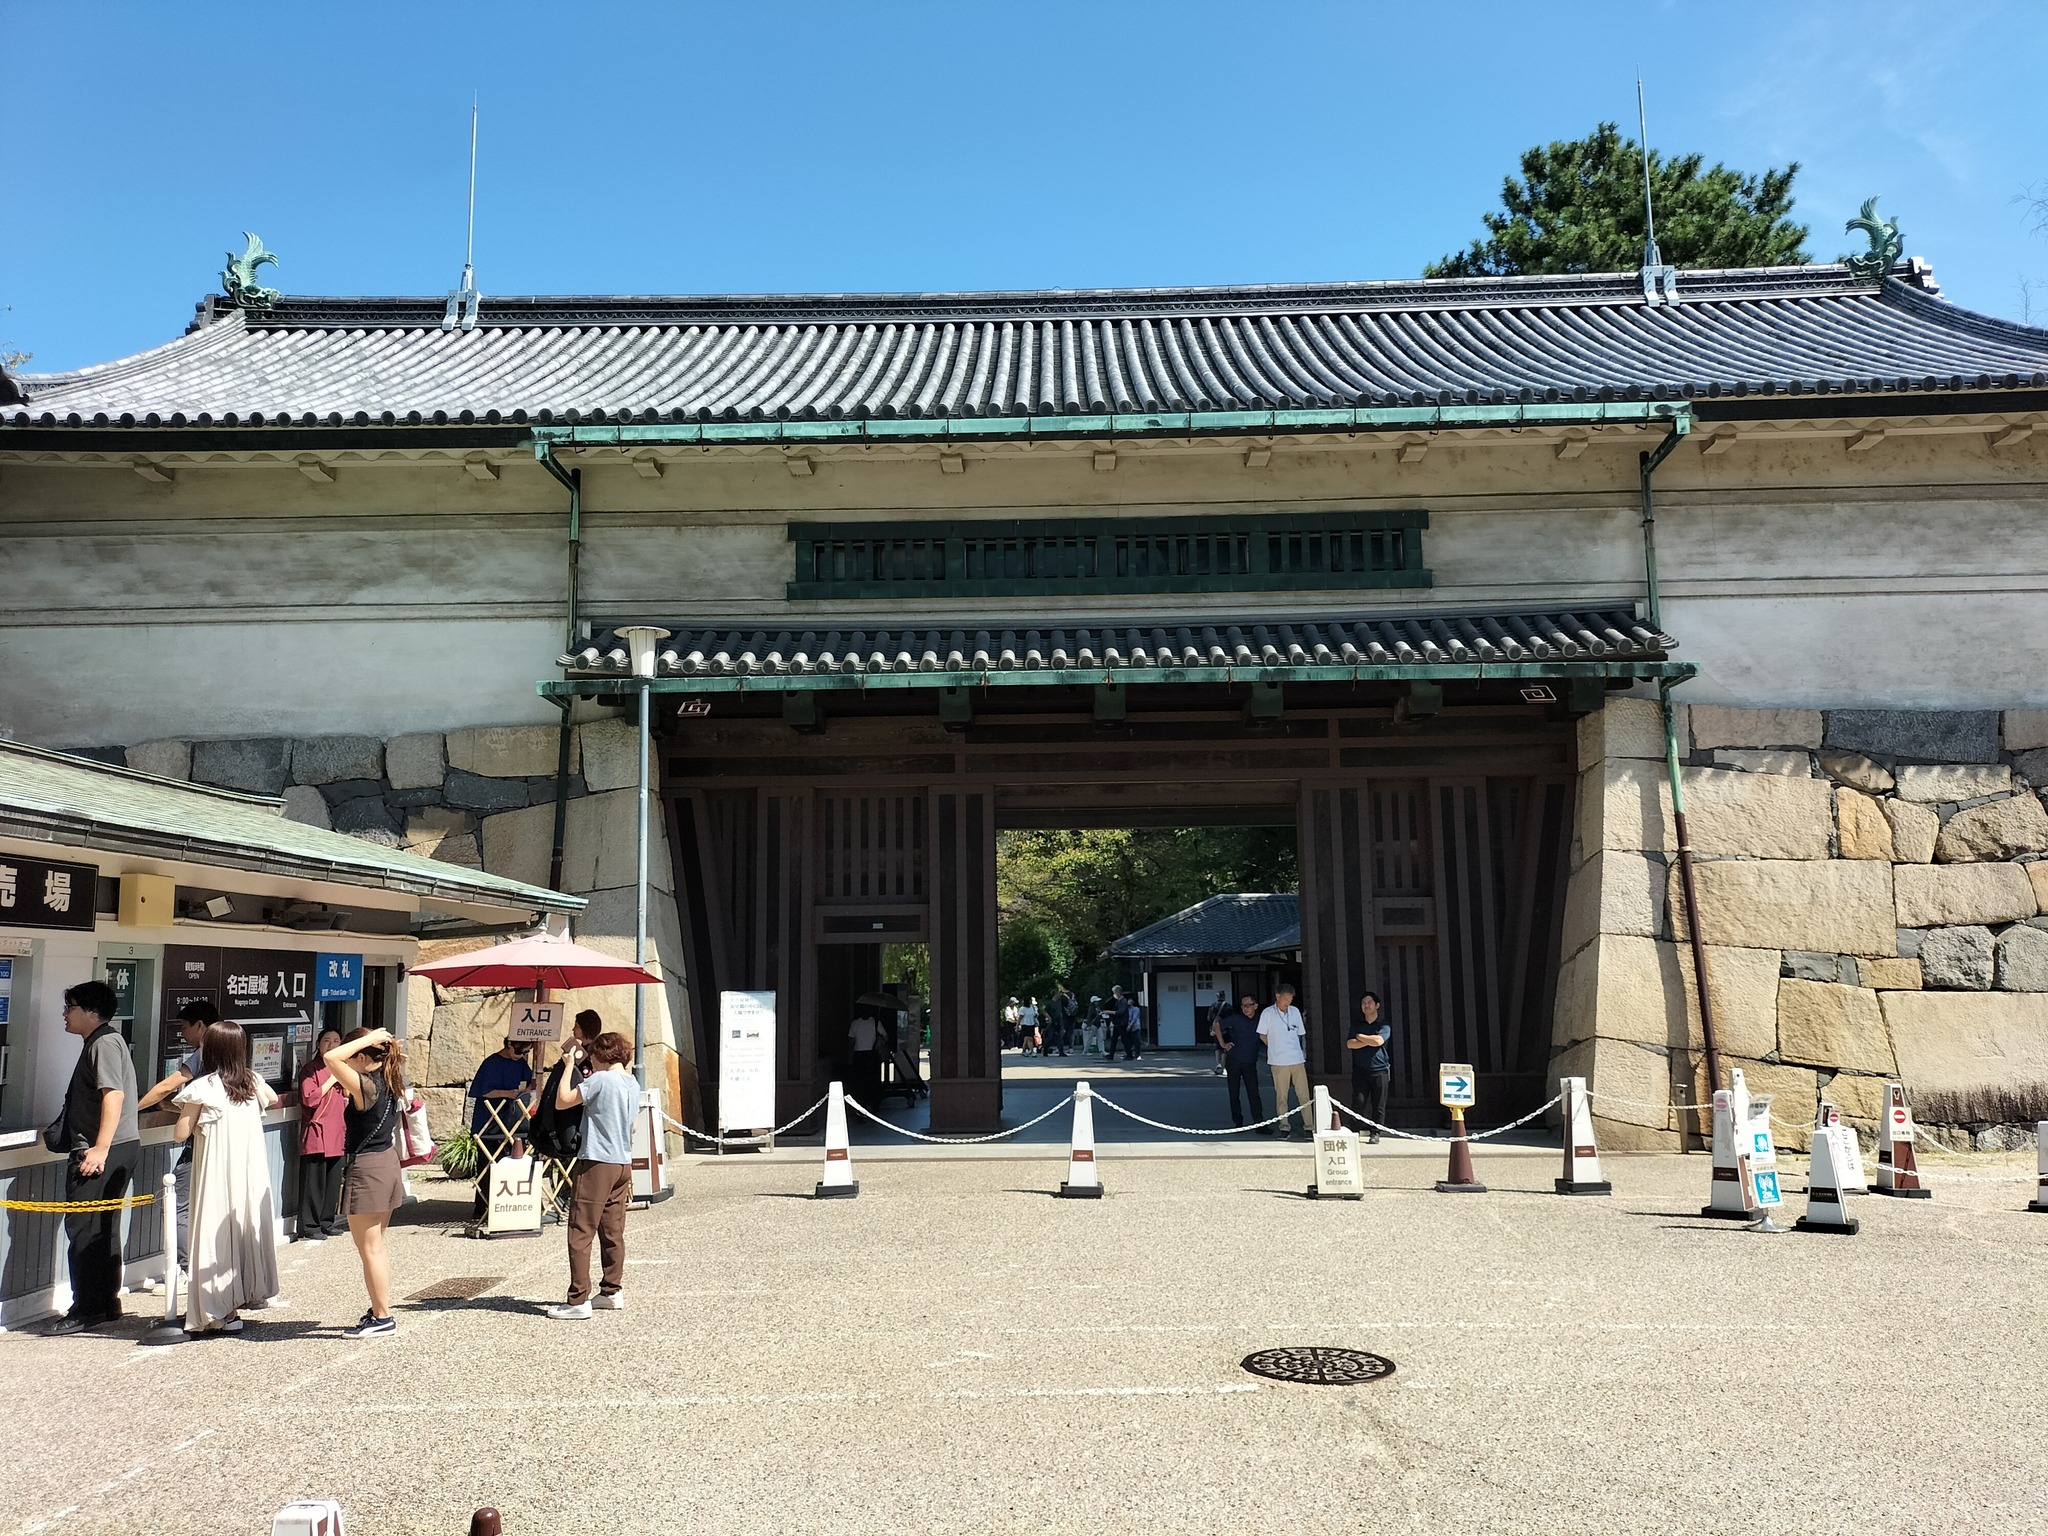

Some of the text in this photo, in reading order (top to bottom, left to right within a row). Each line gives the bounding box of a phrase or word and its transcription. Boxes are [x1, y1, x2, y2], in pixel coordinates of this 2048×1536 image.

[128, 946, 134, 955] 3
[328, 960, 351, 978] 改札
[188, 972, 200, 980] OPEN
[226, 971, 307, 998] 名古屋城 入口
[234, 999, 249, 1007] Nagoya
[521, 1008, 551, 1023] 入口
[516, 1028, 552, 1037] ENTRANCE
[1323, 1140, 1348, 1152] 団体
[1328, 1156, 1346, 1165] 入口
[496, 1180, 532, 1197] 入口
[494, 1203, 534, 1212] Entrance
